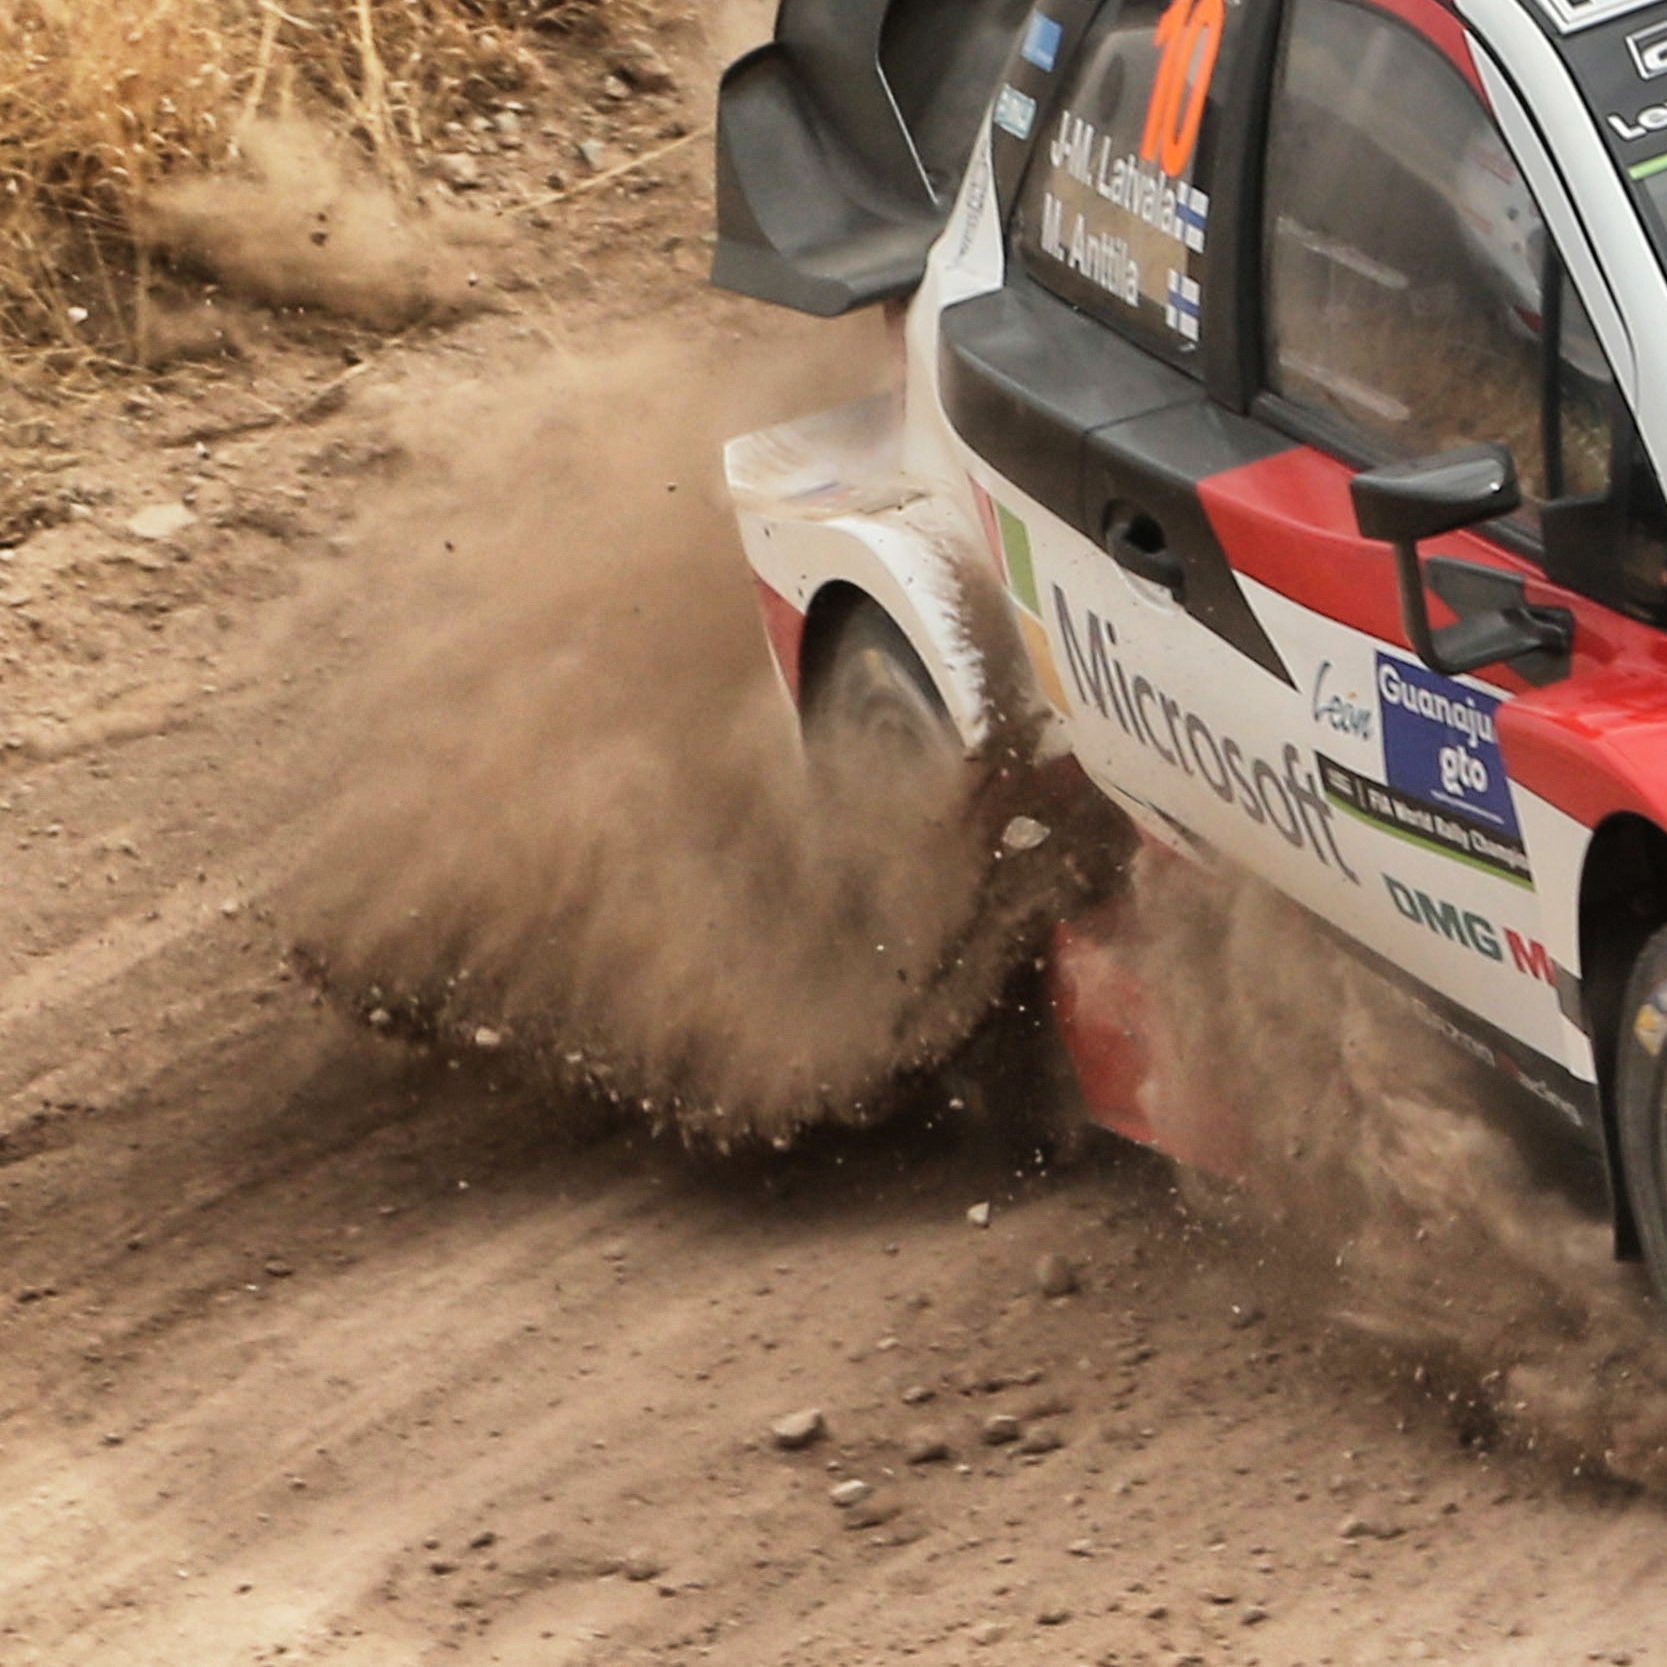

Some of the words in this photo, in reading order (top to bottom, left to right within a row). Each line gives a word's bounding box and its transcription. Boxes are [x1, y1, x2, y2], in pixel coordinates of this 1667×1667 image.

[1097, 135, 1177, 237] Latvala
[1067, 212, 1139, 308] Anttila
[1053, 582, 1361, 887] Microsoft
[1439, 744, 1489, 798] gto
[1381, 871, 1503, 962] DMG
